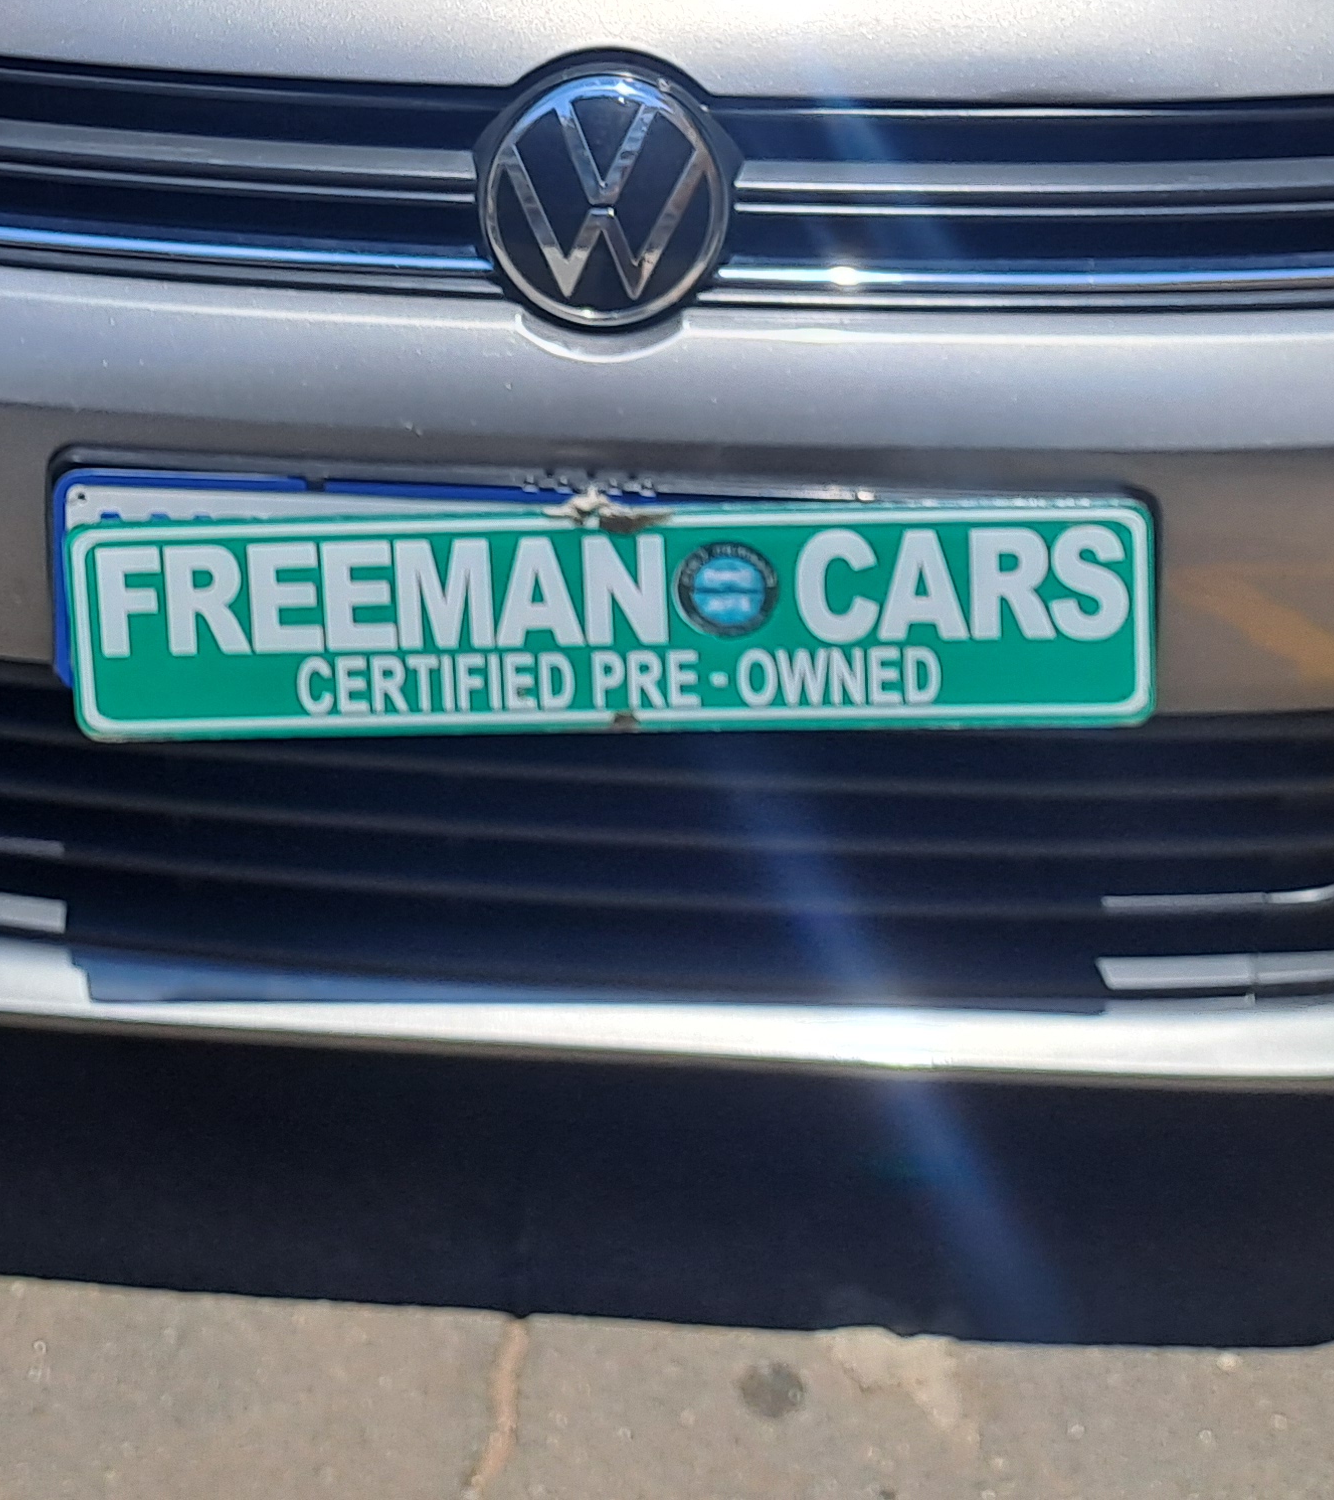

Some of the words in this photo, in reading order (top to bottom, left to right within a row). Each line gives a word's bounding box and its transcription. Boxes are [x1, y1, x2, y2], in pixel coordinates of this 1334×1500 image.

[96, 532, 669, 659] FREEMAN
[796, 524, 1131, 645] CARS
[296, 650, 577, 716] CERTIFIED
